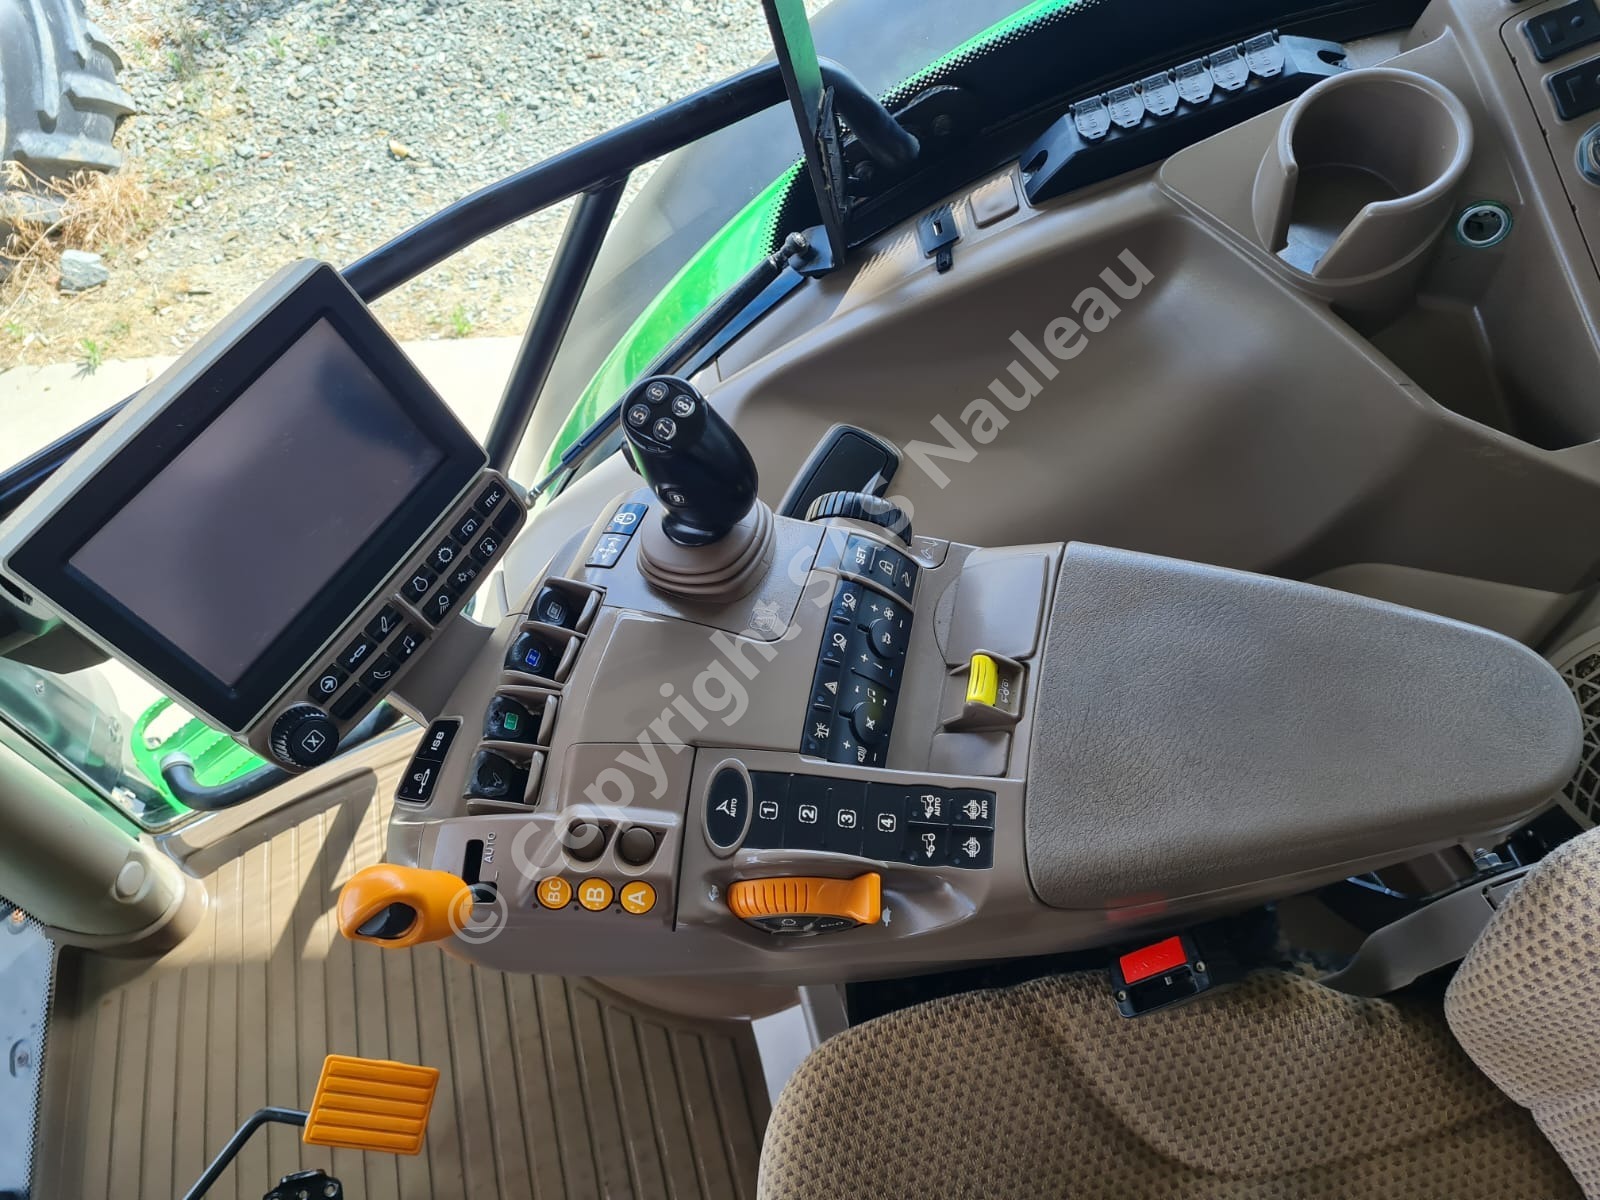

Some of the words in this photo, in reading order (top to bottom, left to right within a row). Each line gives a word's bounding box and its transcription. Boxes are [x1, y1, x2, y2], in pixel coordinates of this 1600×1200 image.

[855, 547, 868, 565] SET
[430, 731, 444, 751] ISB
[729, 798, 737, 817] AUTO
[802, 809, 814, 819] 2
[841, 814, 853, 824] 3
[881, 818, 893, 828] 4
[484, 832, 496, 863] AUTO
[547, 880, 561, 903] BC
[587, 886, 605, 903] B
[628, 890, 646, 906] A
